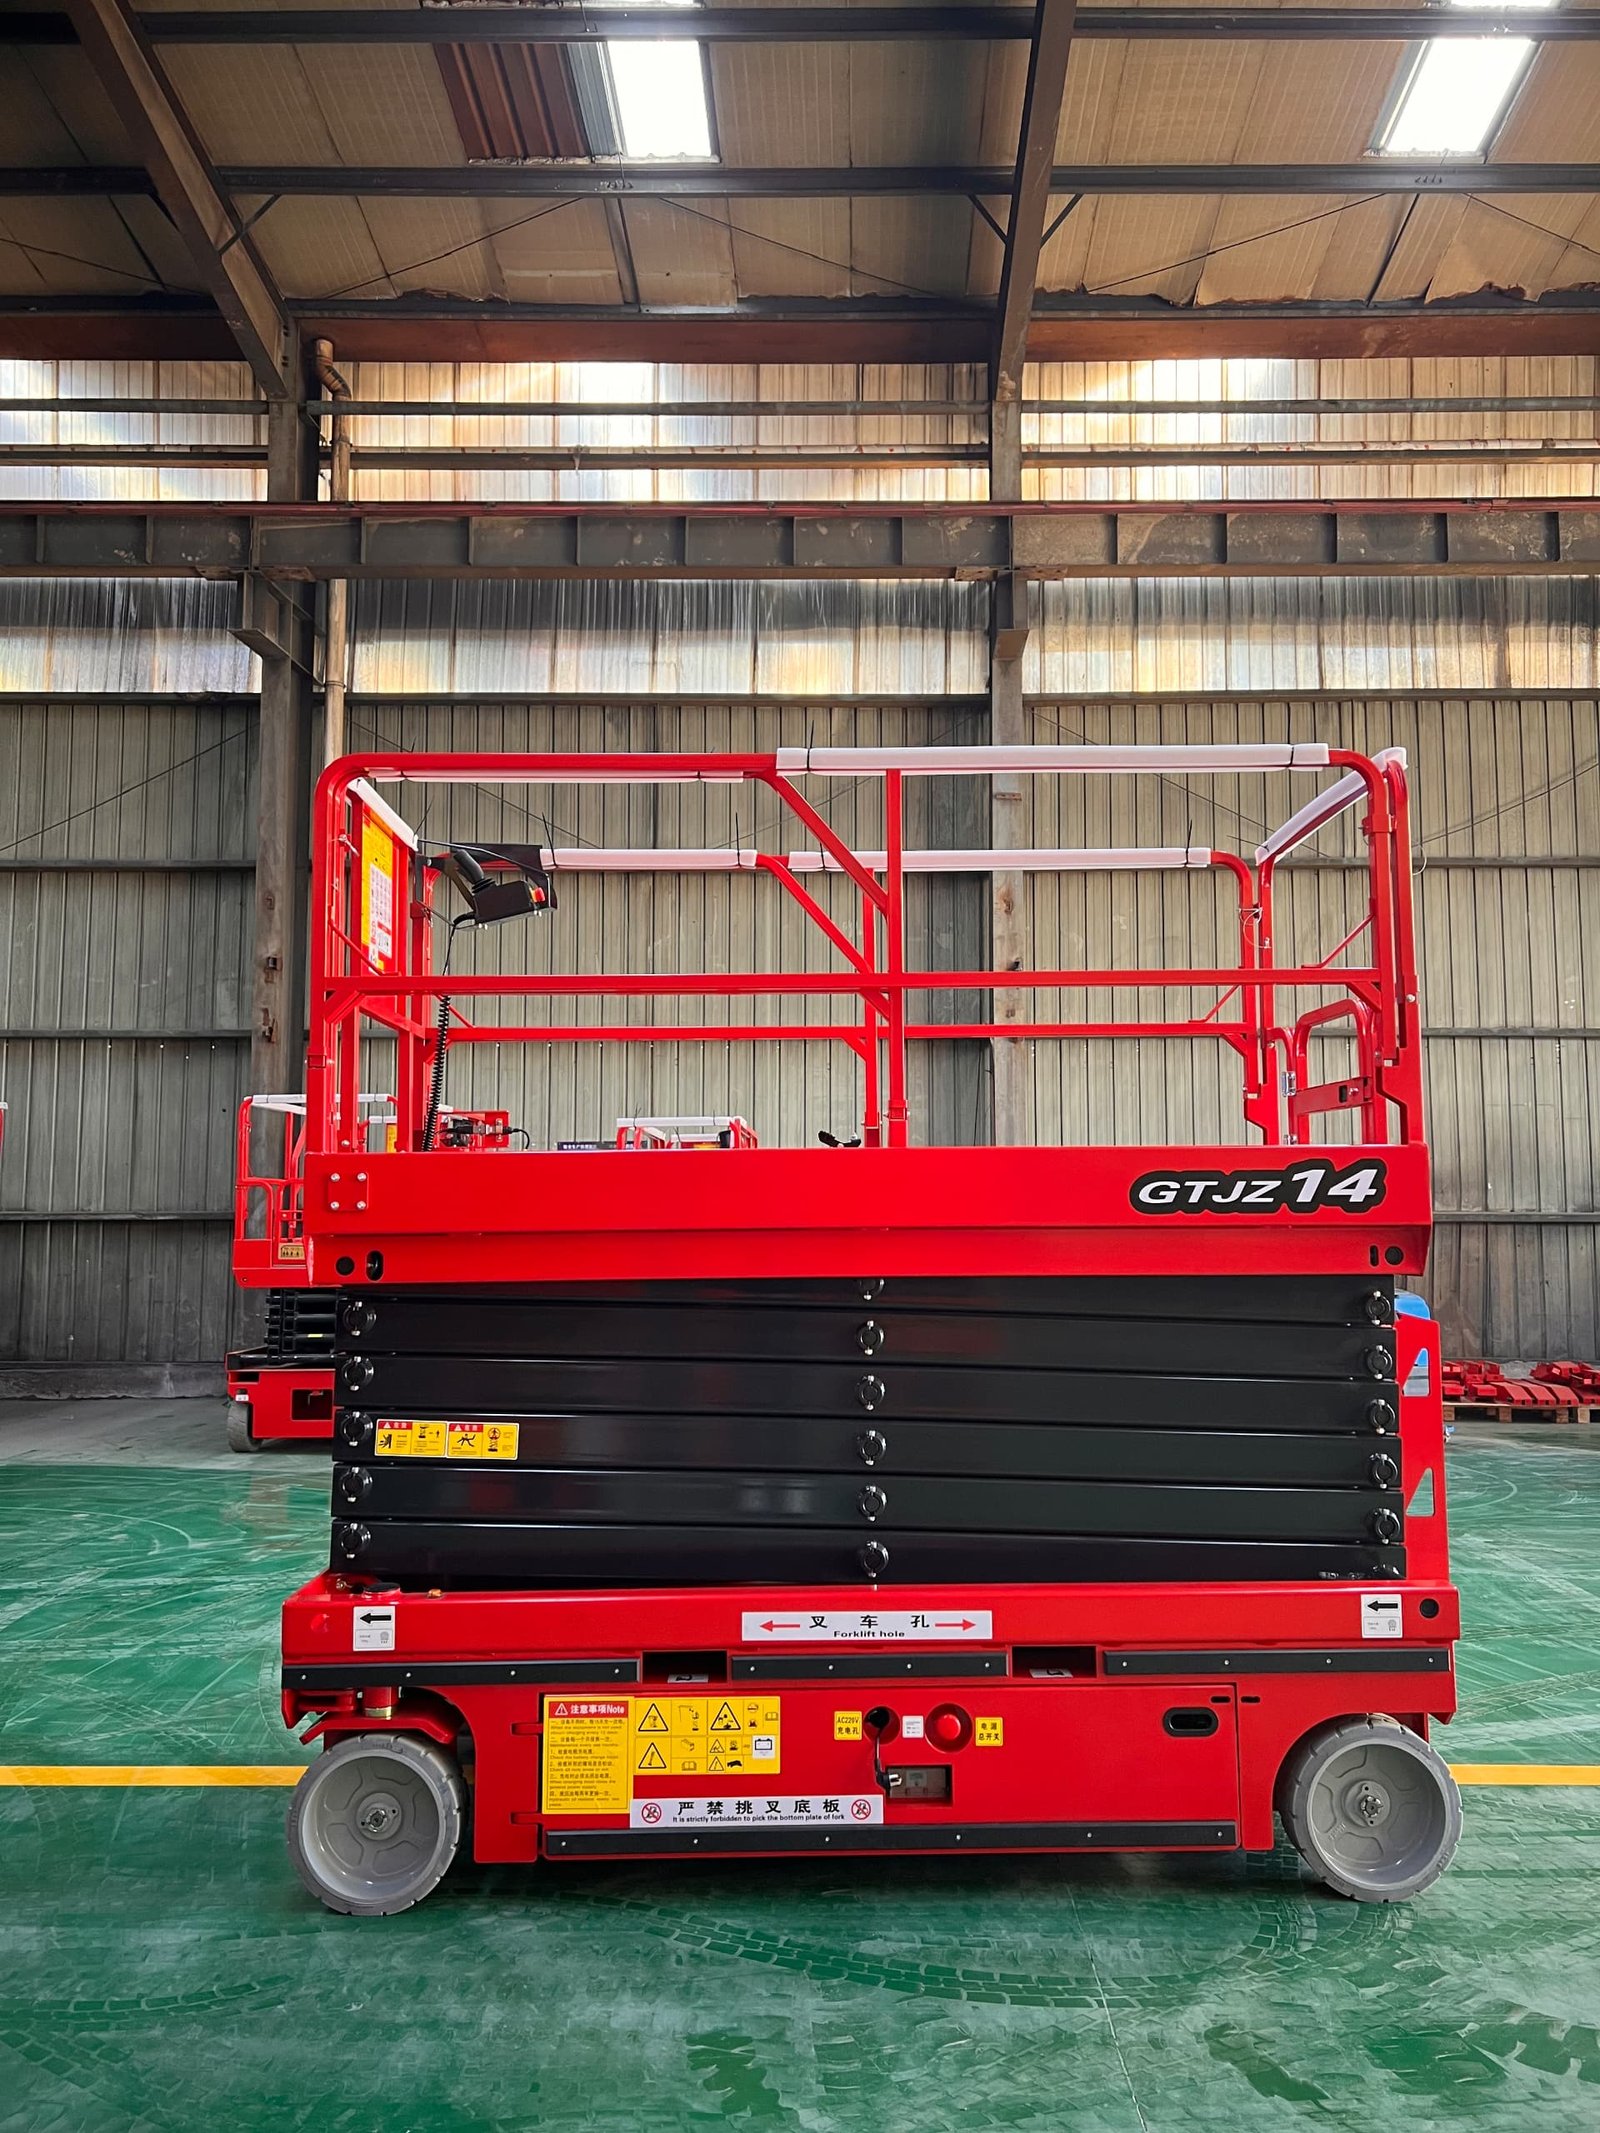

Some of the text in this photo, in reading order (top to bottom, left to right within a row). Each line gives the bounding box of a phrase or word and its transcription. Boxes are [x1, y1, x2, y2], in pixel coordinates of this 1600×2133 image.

[834, 1630, 905, 1638] Forklift hole
[677, 1799, 840, 1815] 严禁挑叉底板
[686, 1815, 708, 1823] strictly
[779, 1813, 804, 1821] bottom
[805, 1813, 821, 1821] plate
